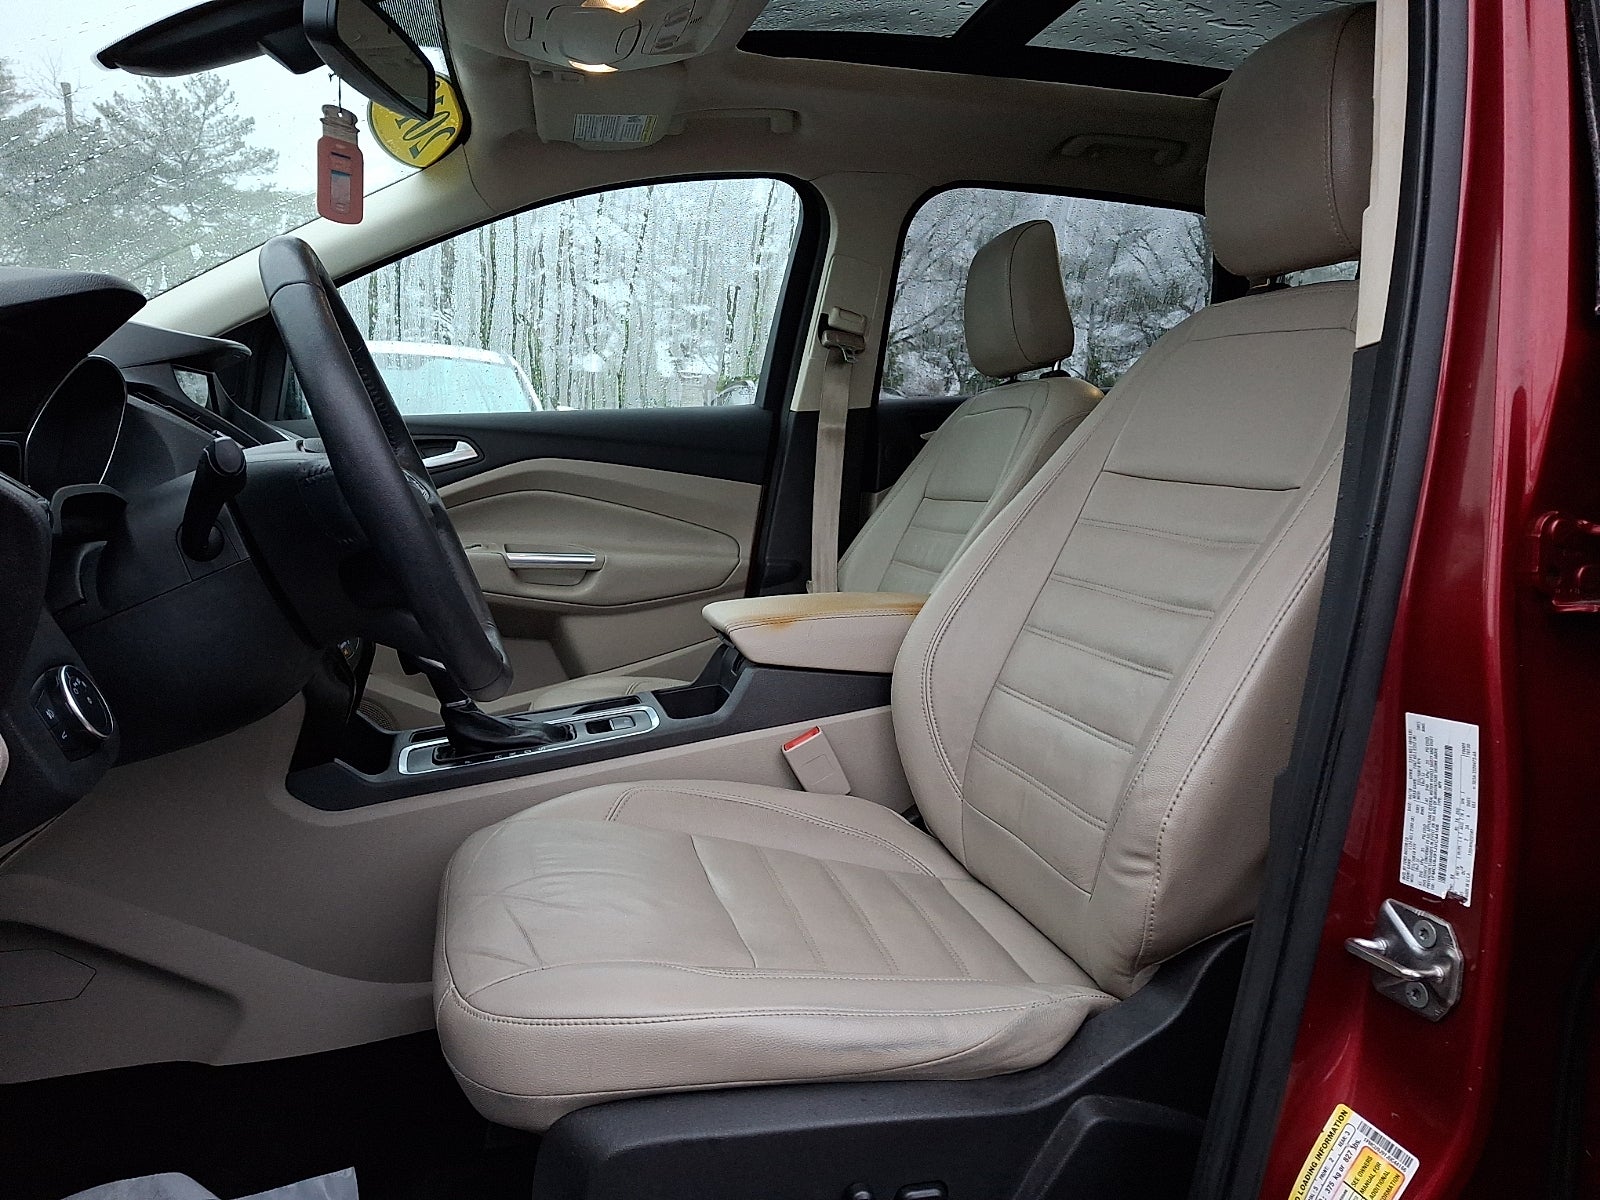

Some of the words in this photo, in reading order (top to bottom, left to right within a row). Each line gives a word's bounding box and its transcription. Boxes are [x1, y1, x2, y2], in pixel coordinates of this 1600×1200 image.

[1298, 1162, 1318, 1195] LOADING
[1315, 1110, 1348, 1161] INFORMATION
[1325, 1180, 1335, 1194] 375
[1333, 1170, 1342, 1180] kg
[1343, 1150, 1353, 1162] 827
[1351, 1176, 1359, 1187] SEE
[1357, 1156, 1373, 1177] OWNERS
[1360, 1173, 1375, 1194] MANUAL
[1372, 1161, 1382, 1174] FOR
[1369, 1171, 1390, 1200] ADDITIONAL
